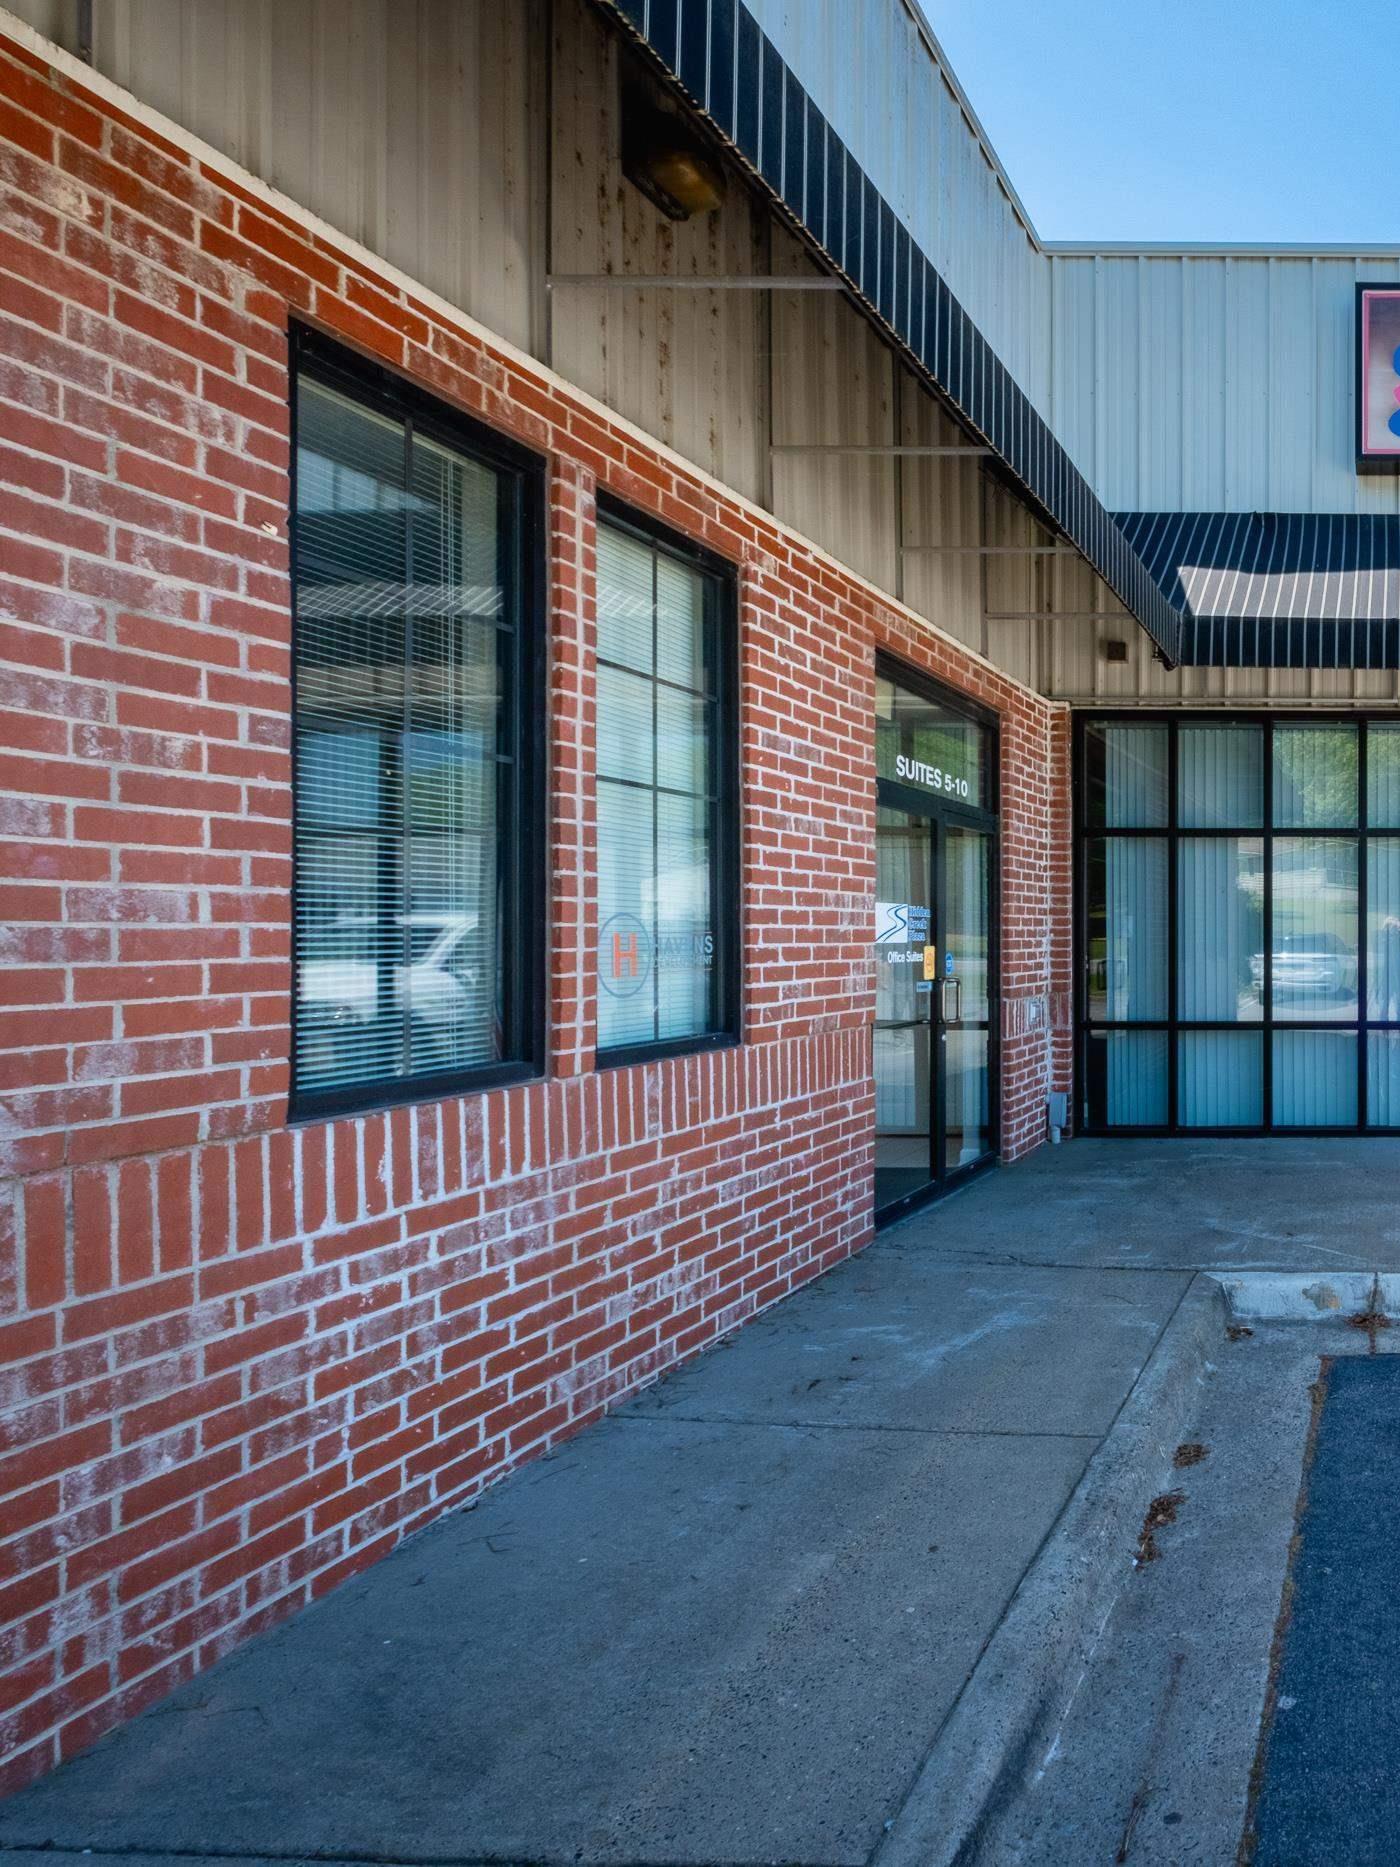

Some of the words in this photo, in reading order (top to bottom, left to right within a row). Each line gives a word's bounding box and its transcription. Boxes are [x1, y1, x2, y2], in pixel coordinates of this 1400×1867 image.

[896, 755, 943, 789] SUITES
[944, 775, 969, 798] 5-10
[887, 951, 906, 964] Office
[906, 950, 924, 962] Suites
